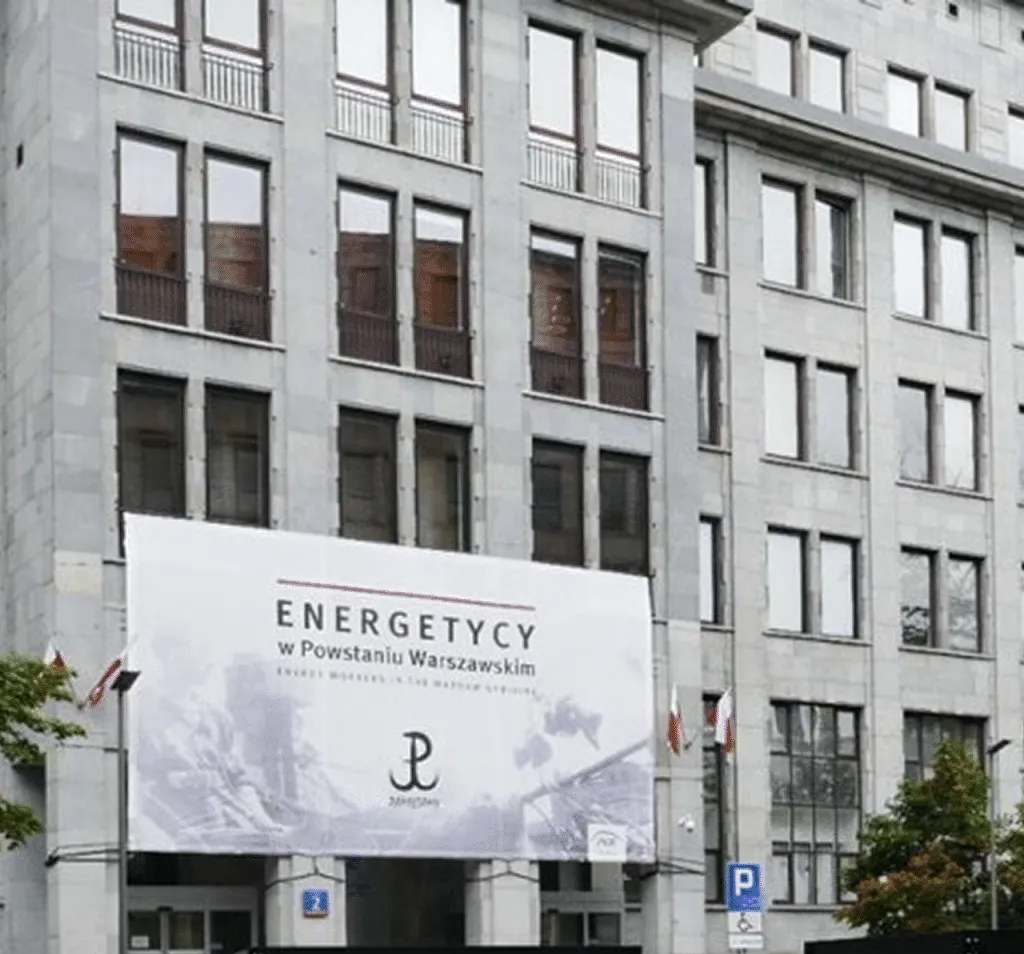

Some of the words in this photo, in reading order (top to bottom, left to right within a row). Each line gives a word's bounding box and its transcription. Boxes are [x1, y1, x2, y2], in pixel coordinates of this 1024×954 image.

[276, 599, 536, 650] ENERGETYCY
[278, 641, 296, 656] w
[301, 639, 403, 666] Powstaniu
[409, 649, 536, 677] Warszawskim
[734, 868, 753, 897] P
